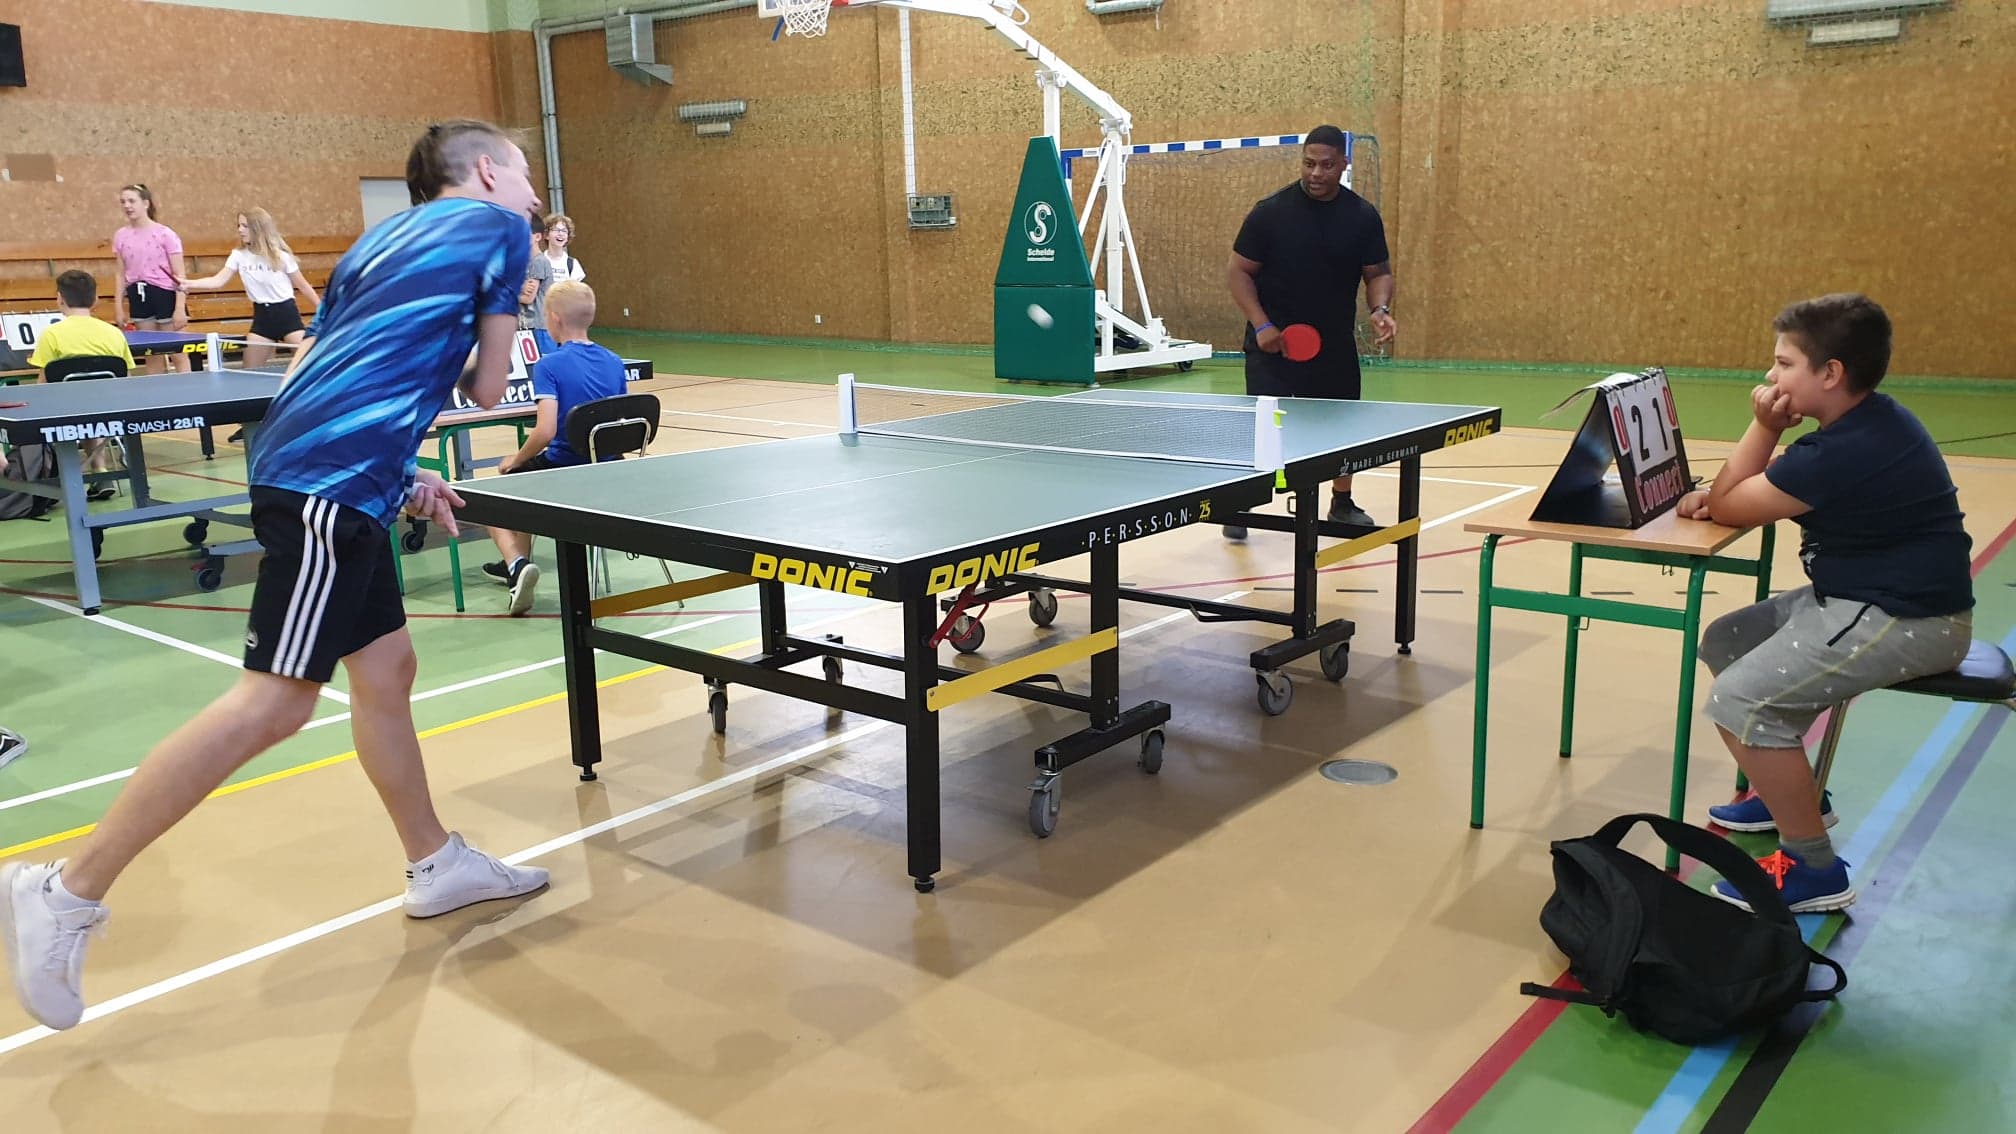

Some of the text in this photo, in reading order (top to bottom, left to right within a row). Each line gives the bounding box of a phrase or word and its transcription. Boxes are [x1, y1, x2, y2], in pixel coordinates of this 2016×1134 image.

[18, 322, 35, 345] 0
[521, 337, 537, 362] 0
[40, 416, 205, 443] TIBHAR SMASH 28/R
[1613, 405, 1628, 450] 0
[1662, 386, 1676, 427] 0
[1443, 418, 1494, 448] DONIC
[1352, 445, 1418, 471] MADE IN GERMANY
[751, 552, 873, 597] DONIC
[926, 542, 1040, 596] DONIC
